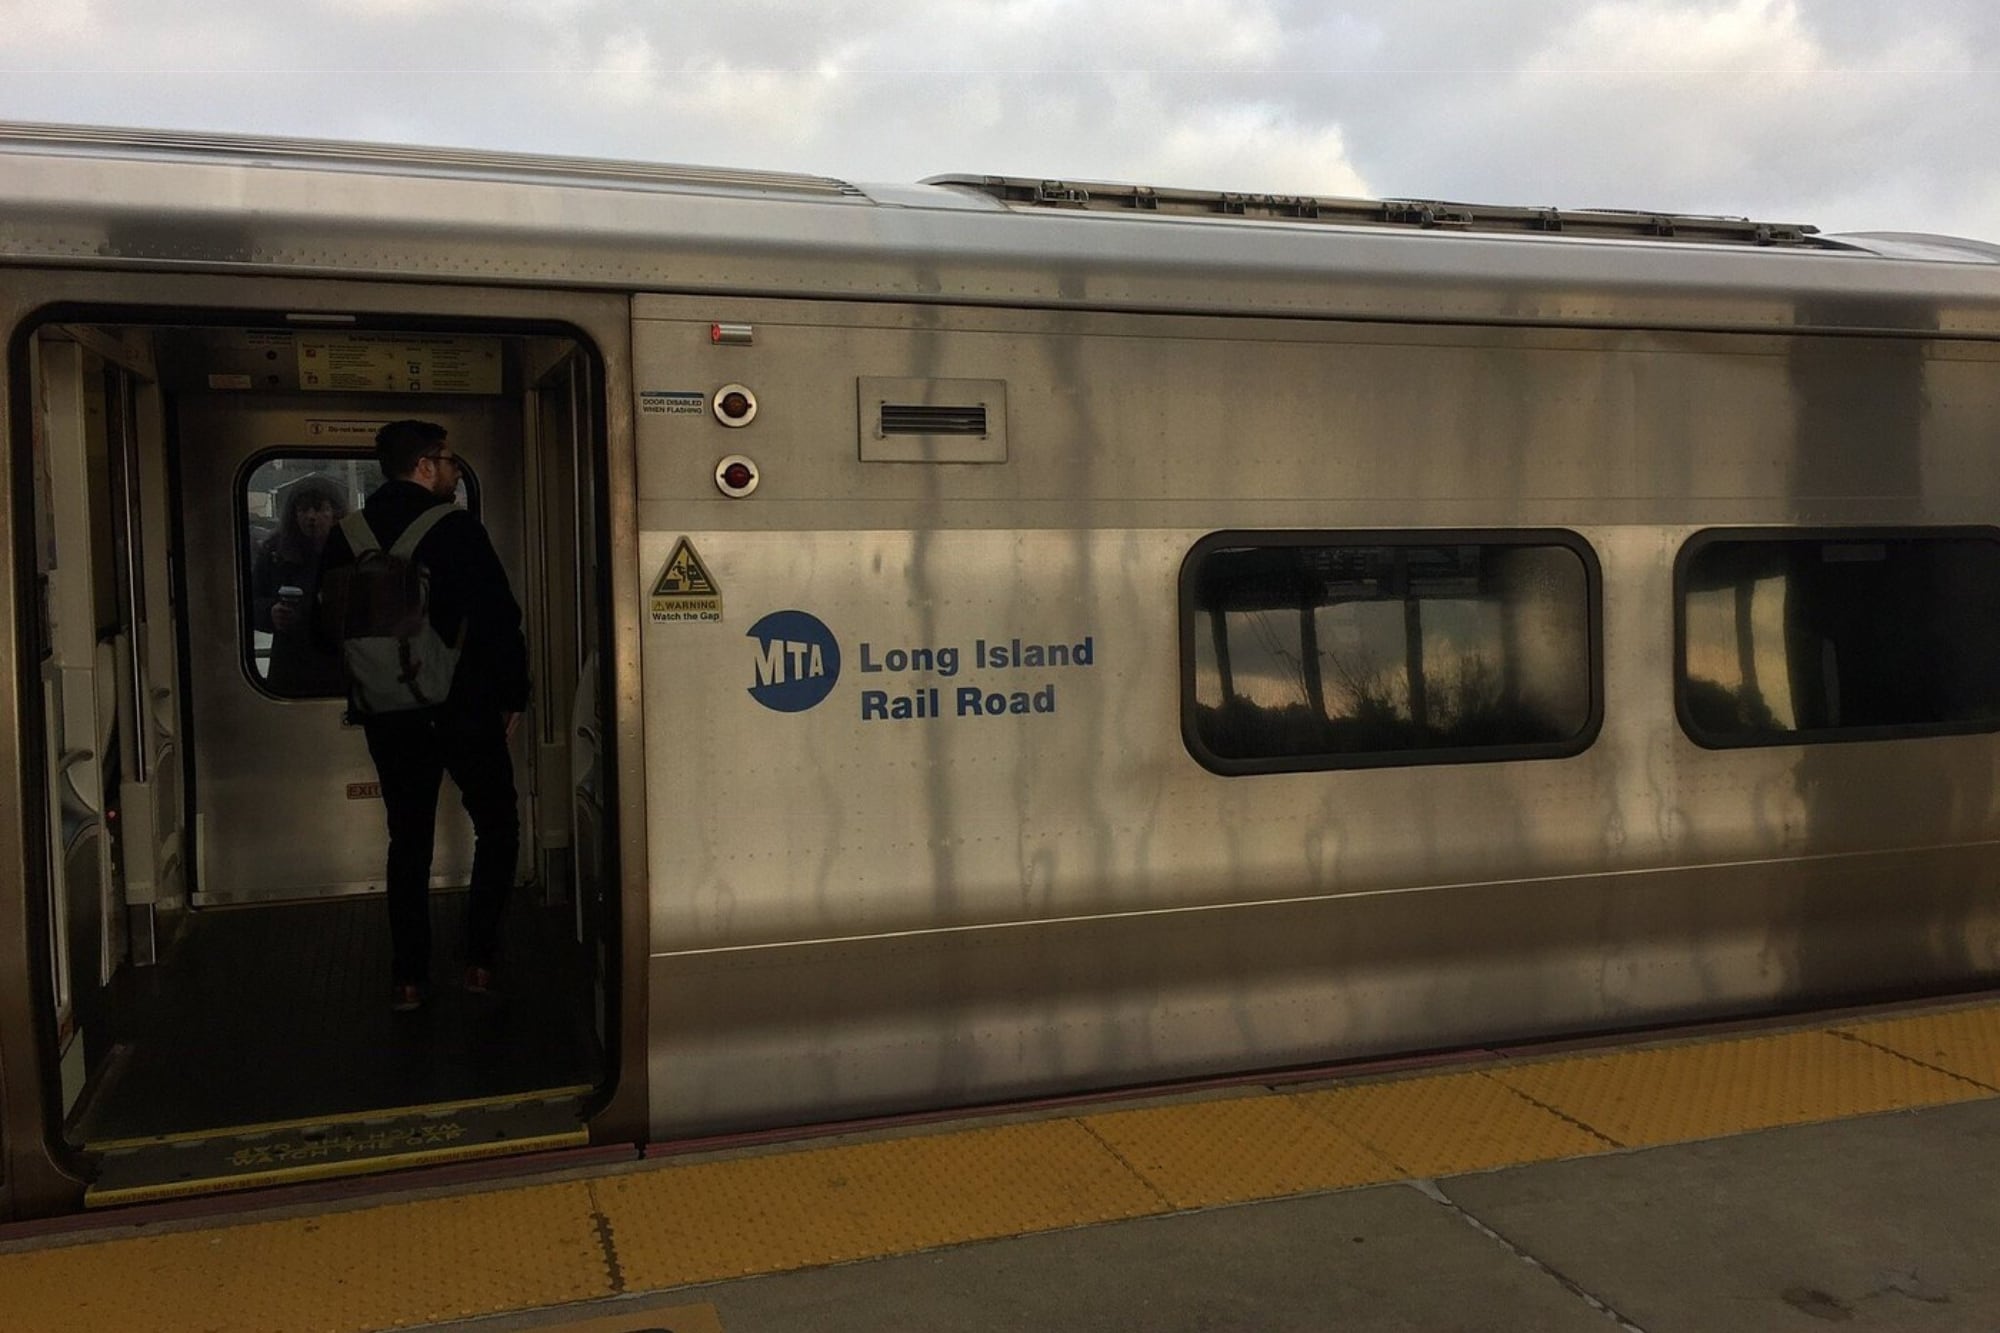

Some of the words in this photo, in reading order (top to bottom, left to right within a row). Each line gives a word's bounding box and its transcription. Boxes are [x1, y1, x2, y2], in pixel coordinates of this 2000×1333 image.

[652, 612, 681, 620] Watch
[684, 612, 698, 620] the
[700, 611, 720, 621] Gap
[665, 600, 716, 609] WARNING
[749, 636, 825, 689] MTA
[860, 643, 959, 676] Long
[976, 637, 1094, 669] Island
[861, 688, 939, 720] Rail
[956, 684, 1055, 717] Road
[350, 785, 379, 796] EXIT
